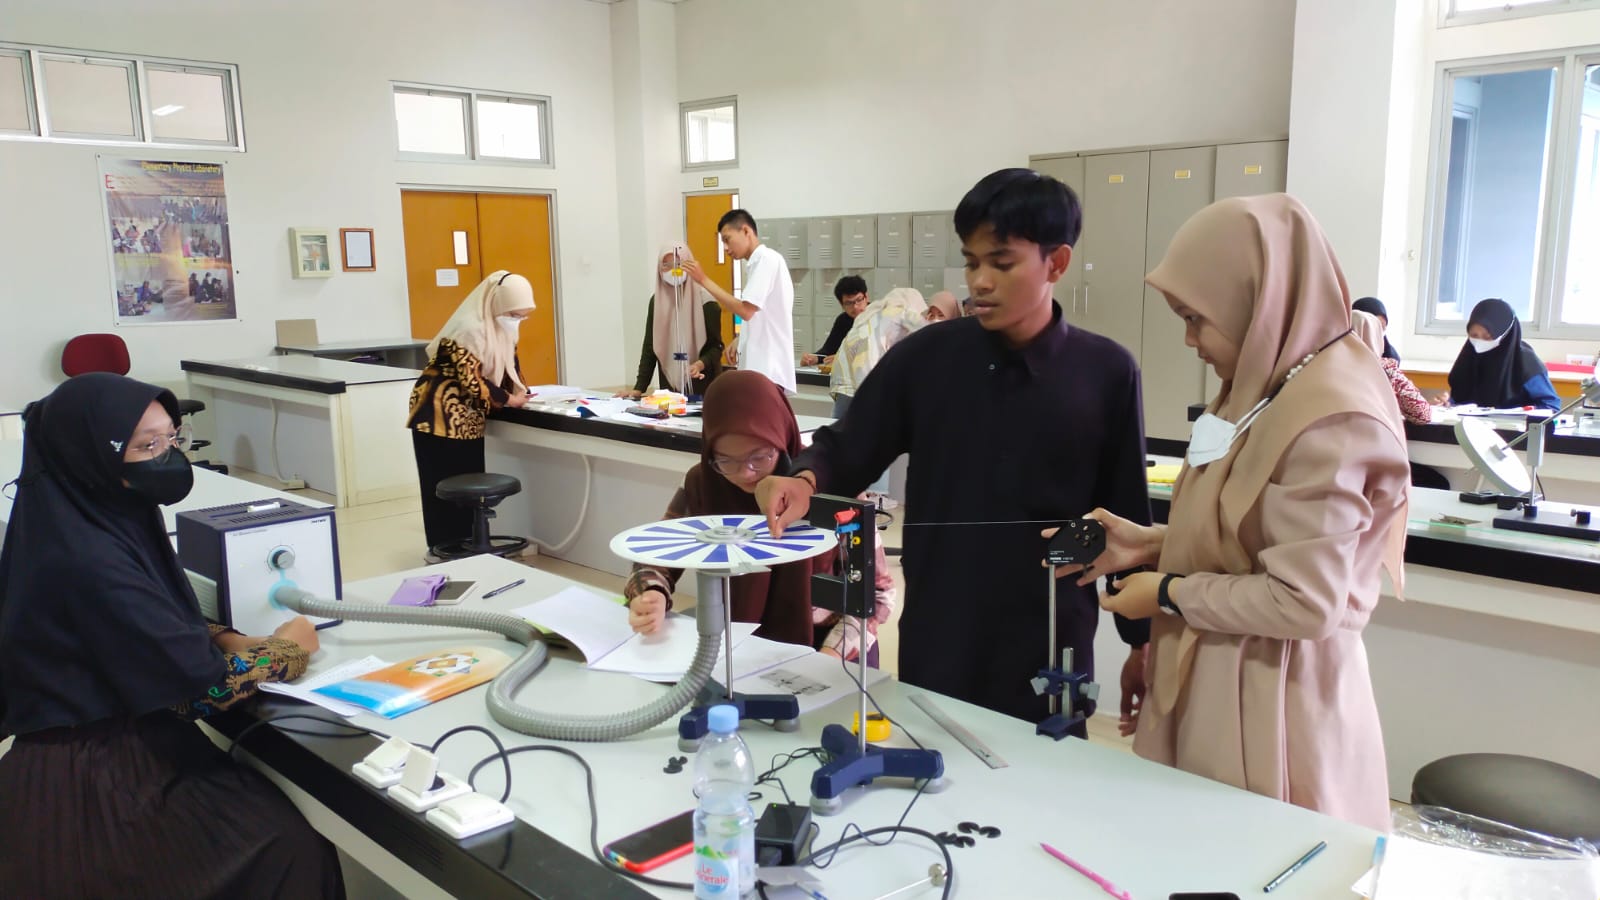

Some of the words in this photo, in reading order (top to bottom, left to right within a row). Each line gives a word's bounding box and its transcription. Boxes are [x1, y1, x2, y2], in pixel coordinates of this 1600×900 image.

[173, 162, 192, 173] Physics
[193, 164, 221, 175] Laboratory
[702, 863, 712, 874] Le
